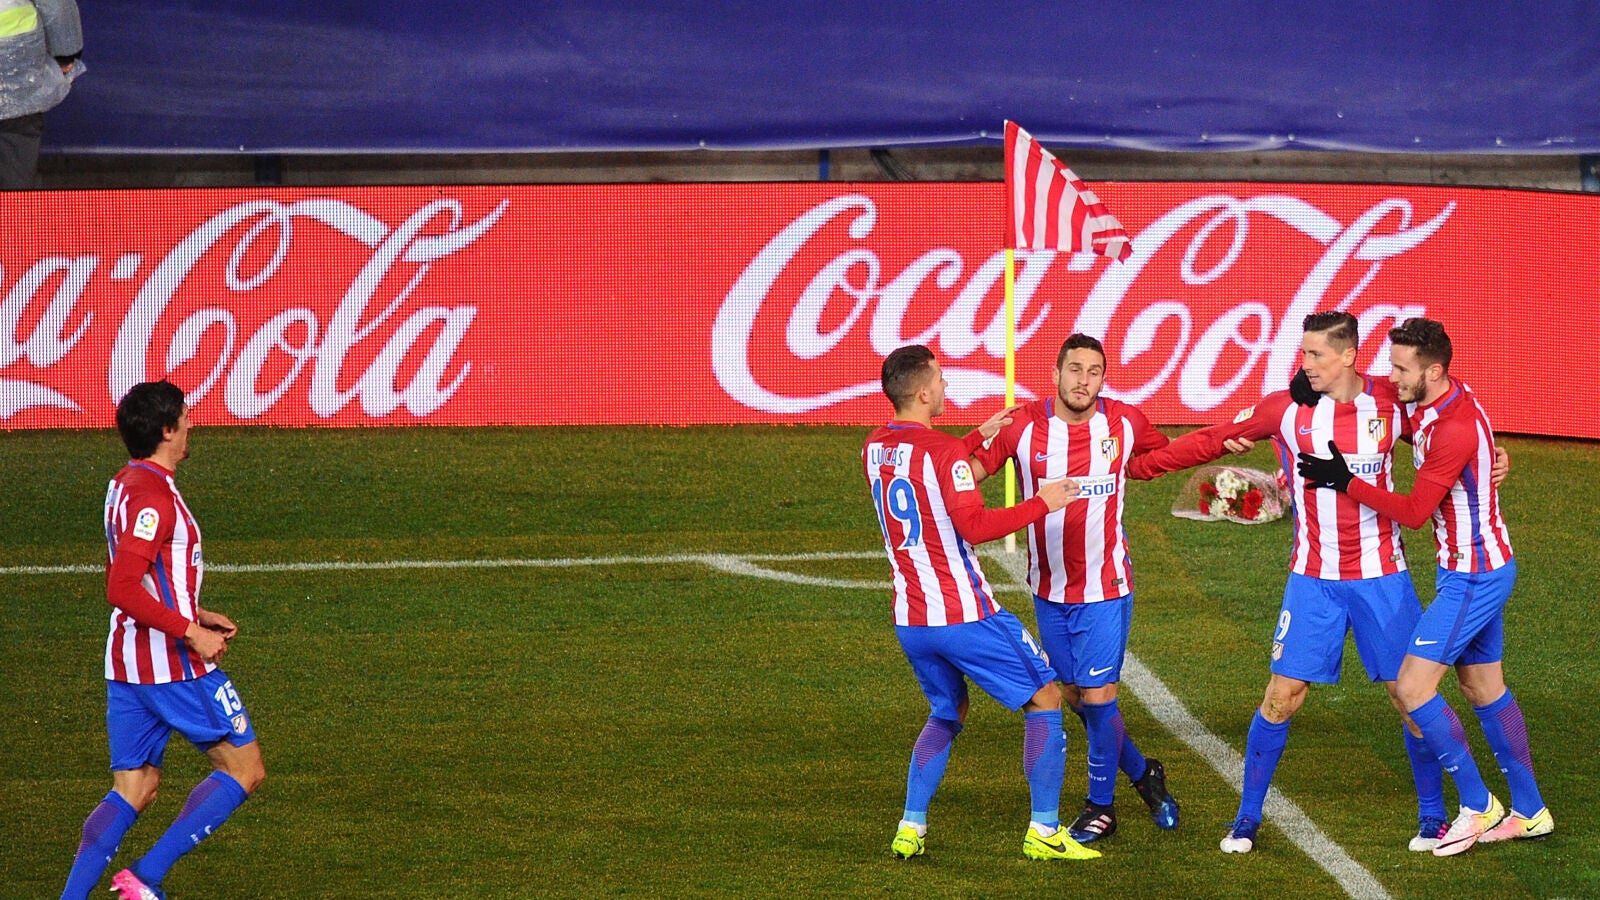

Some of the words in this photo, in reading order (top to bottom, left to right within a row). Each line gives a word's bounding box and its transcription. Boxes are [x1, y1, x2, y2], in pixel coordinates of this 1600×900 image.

[0, 199, 510, 420] a-Cola
[870, 447, 905, 467] LUCAS
[871, 477, 921, 549] 19
[1021, 628, 1041, 656] 1
[1276, 609, 1291, 641] 9
[214, 680, 242, 717] 15
